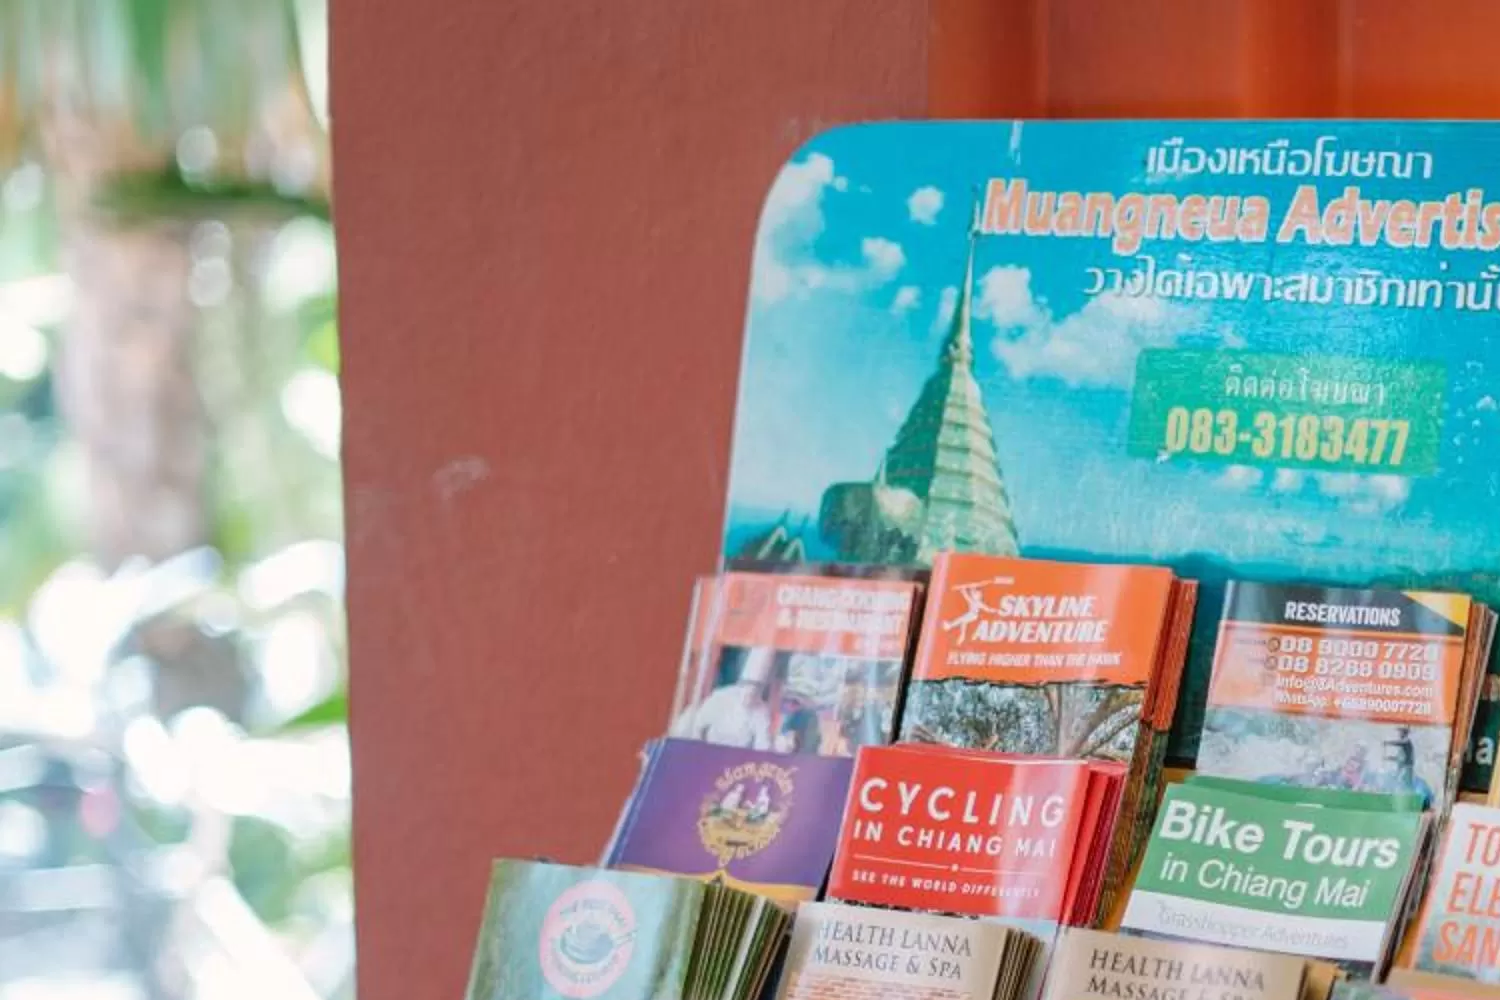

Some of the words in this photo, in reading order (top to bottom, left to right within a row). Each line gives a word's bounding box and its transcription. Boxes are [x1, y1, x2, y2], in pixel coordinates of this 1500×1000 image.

[981, 177, 1270, 256] Muangneua
[1166, 406, 1410, 466] 083-3183477
[1000, 594, 1097, 618] SKYLINE
[1284, 602, 1401, 626] RESERVATIONS
[972, 620, 1108, 643] ADVENTURE
[947, 651, 986, 666] FLYING
[988, 652, 1031, 667] HIGHER
[1033, 653, 1064, 667] THAN
[1066, 653, 1086, 667] THE
[859, 777, 1065, 828] CYCLING
[853, 819, 883, 842] IN
[897, 826, 1002, 855] CHIANG
[1015, 838, 1057, 858] MAI
[1159, 799, 1265, 854] Bike
[1282, 819, 1401, 869] Tours
[852, 869, 876, 884] SEE
[882, 873, 905, 888] THE
[911, 877, 958, 893] WORLD
[1160, 852, 1190, 883] in
[1197, 859, 1309, 910] Chiang
[1313, 877, 1371, 909] Mai
[819, 919, 895, 948] HEALTH
[900, 929, 972, 957] LANNA
[814, 946, 899, 973] MASSAGE
[906, 955, 921, 975] &
[928, 957, 961, 979] SPA
[1090, 947, 1184, 982] HEALTH
[1190, 963, 1265, 992] LANNA
